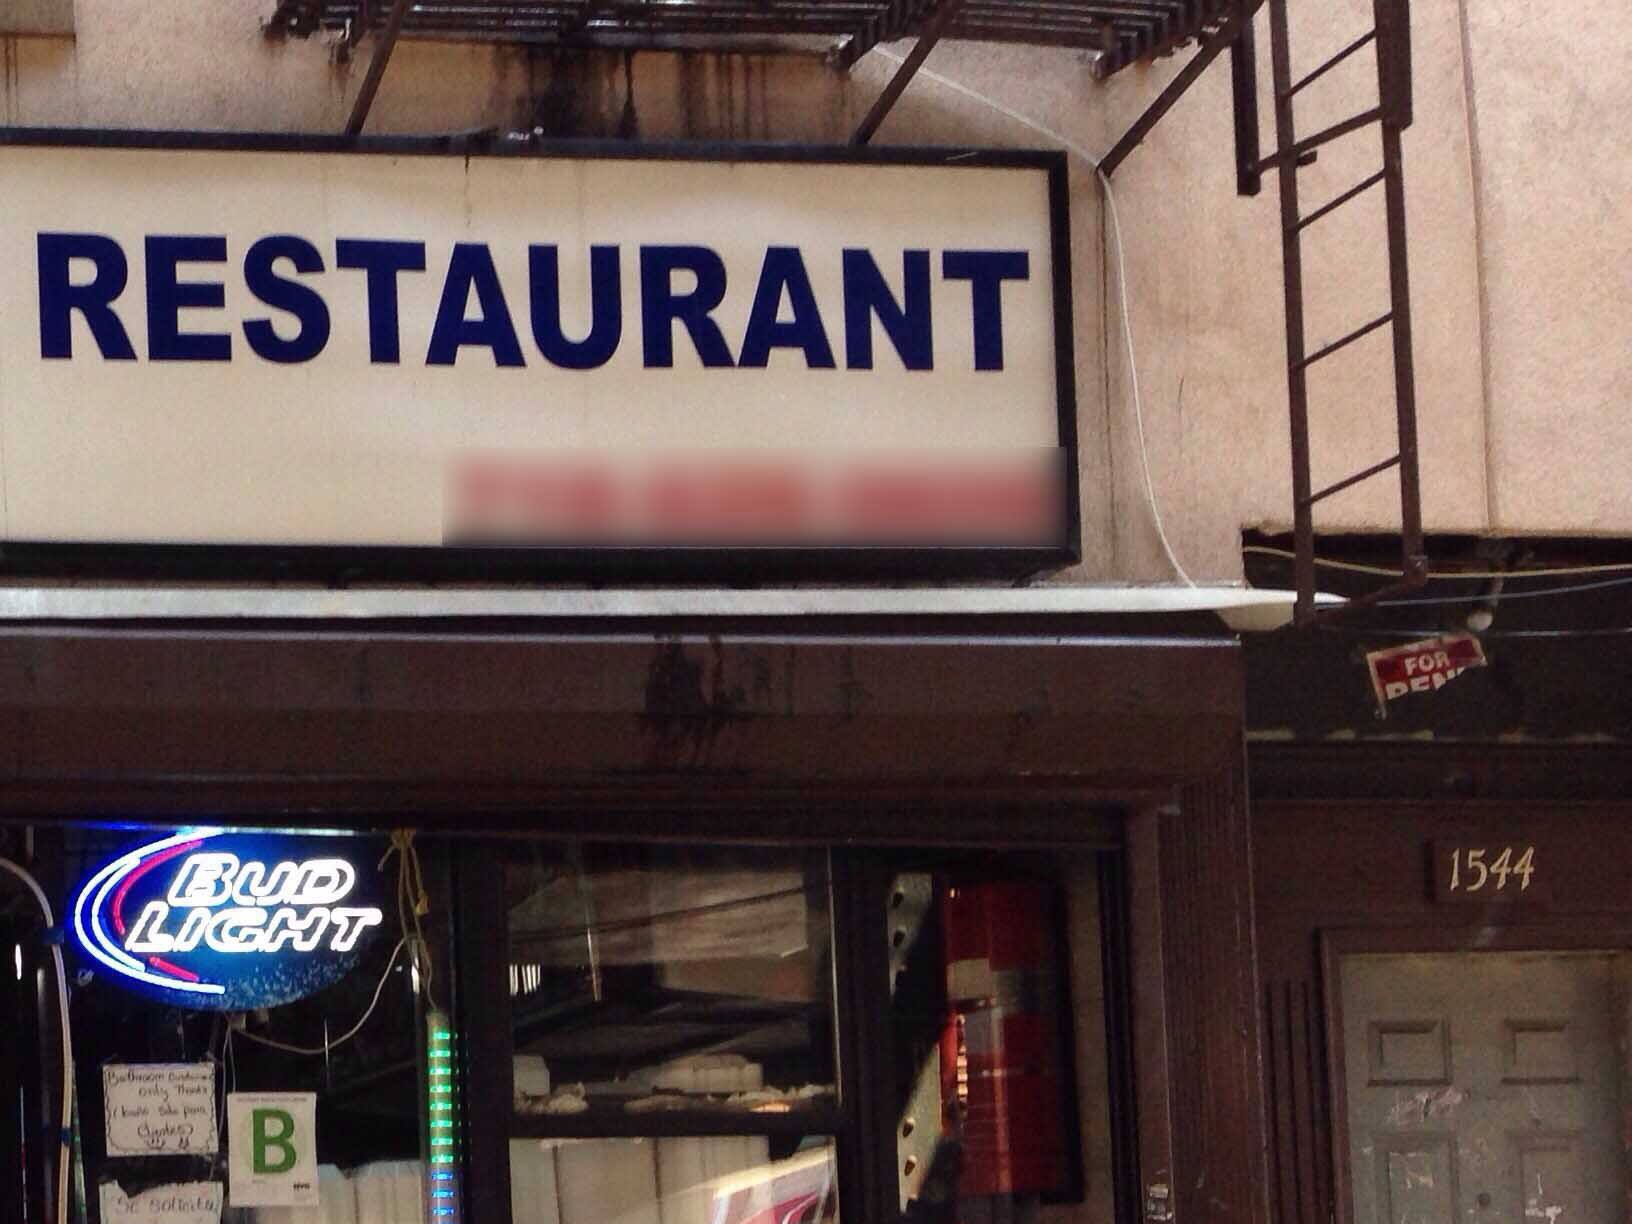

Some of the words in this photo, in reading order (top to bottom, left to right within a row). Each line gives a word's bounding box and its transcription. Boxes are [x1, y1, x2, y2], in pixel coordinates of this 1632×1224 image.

[36, 232, 1029, 372] RESTAURANT
[1404, 651, 1451, 676] FOR
[167, 852, 355, 908] BUD
[1450, 846, 1534, 891] 1544
[125, 900, 383, 953] LIGHT
[252, 1108, 297, 1174] B
